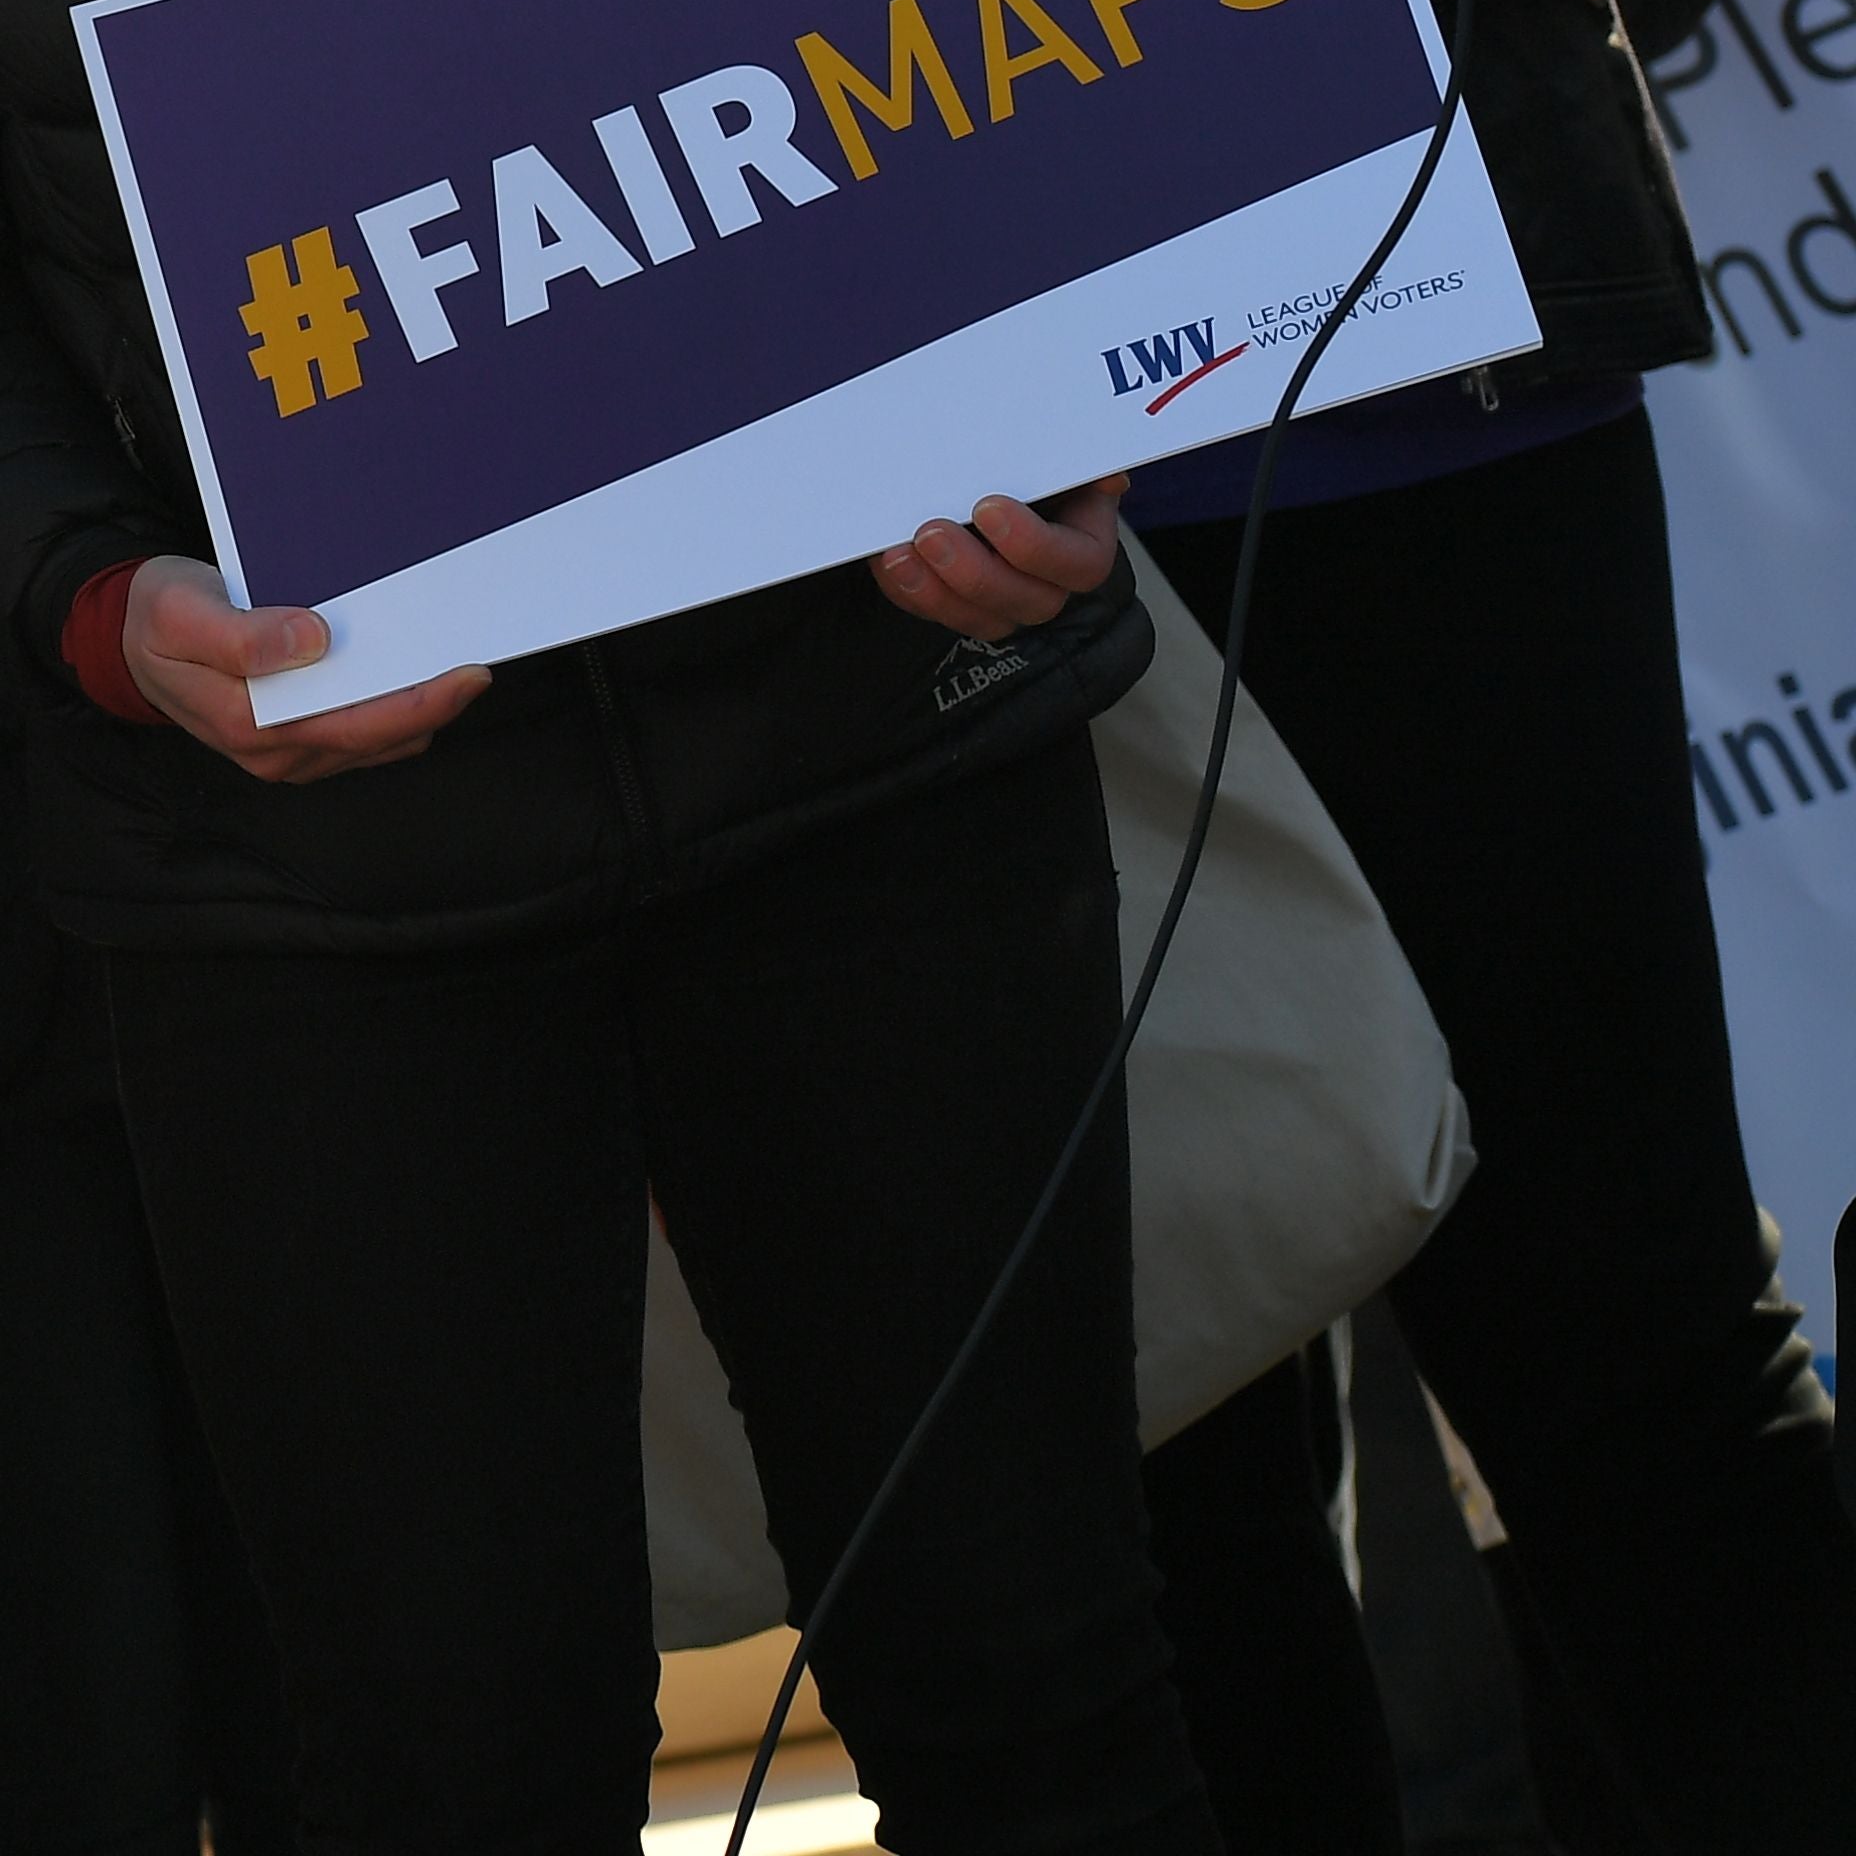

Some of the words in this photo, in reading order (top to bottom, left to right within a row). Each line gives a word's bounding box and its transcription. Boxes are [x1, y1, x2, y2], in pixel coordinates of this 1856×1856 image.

[1246, 283, 1345, 330] LEAGUE
[1360, 271, 1465, 315] VOTERS
[1100, 316, 1216, 397] LWV
[932, 654, 1030, 713] L.L.Bean
